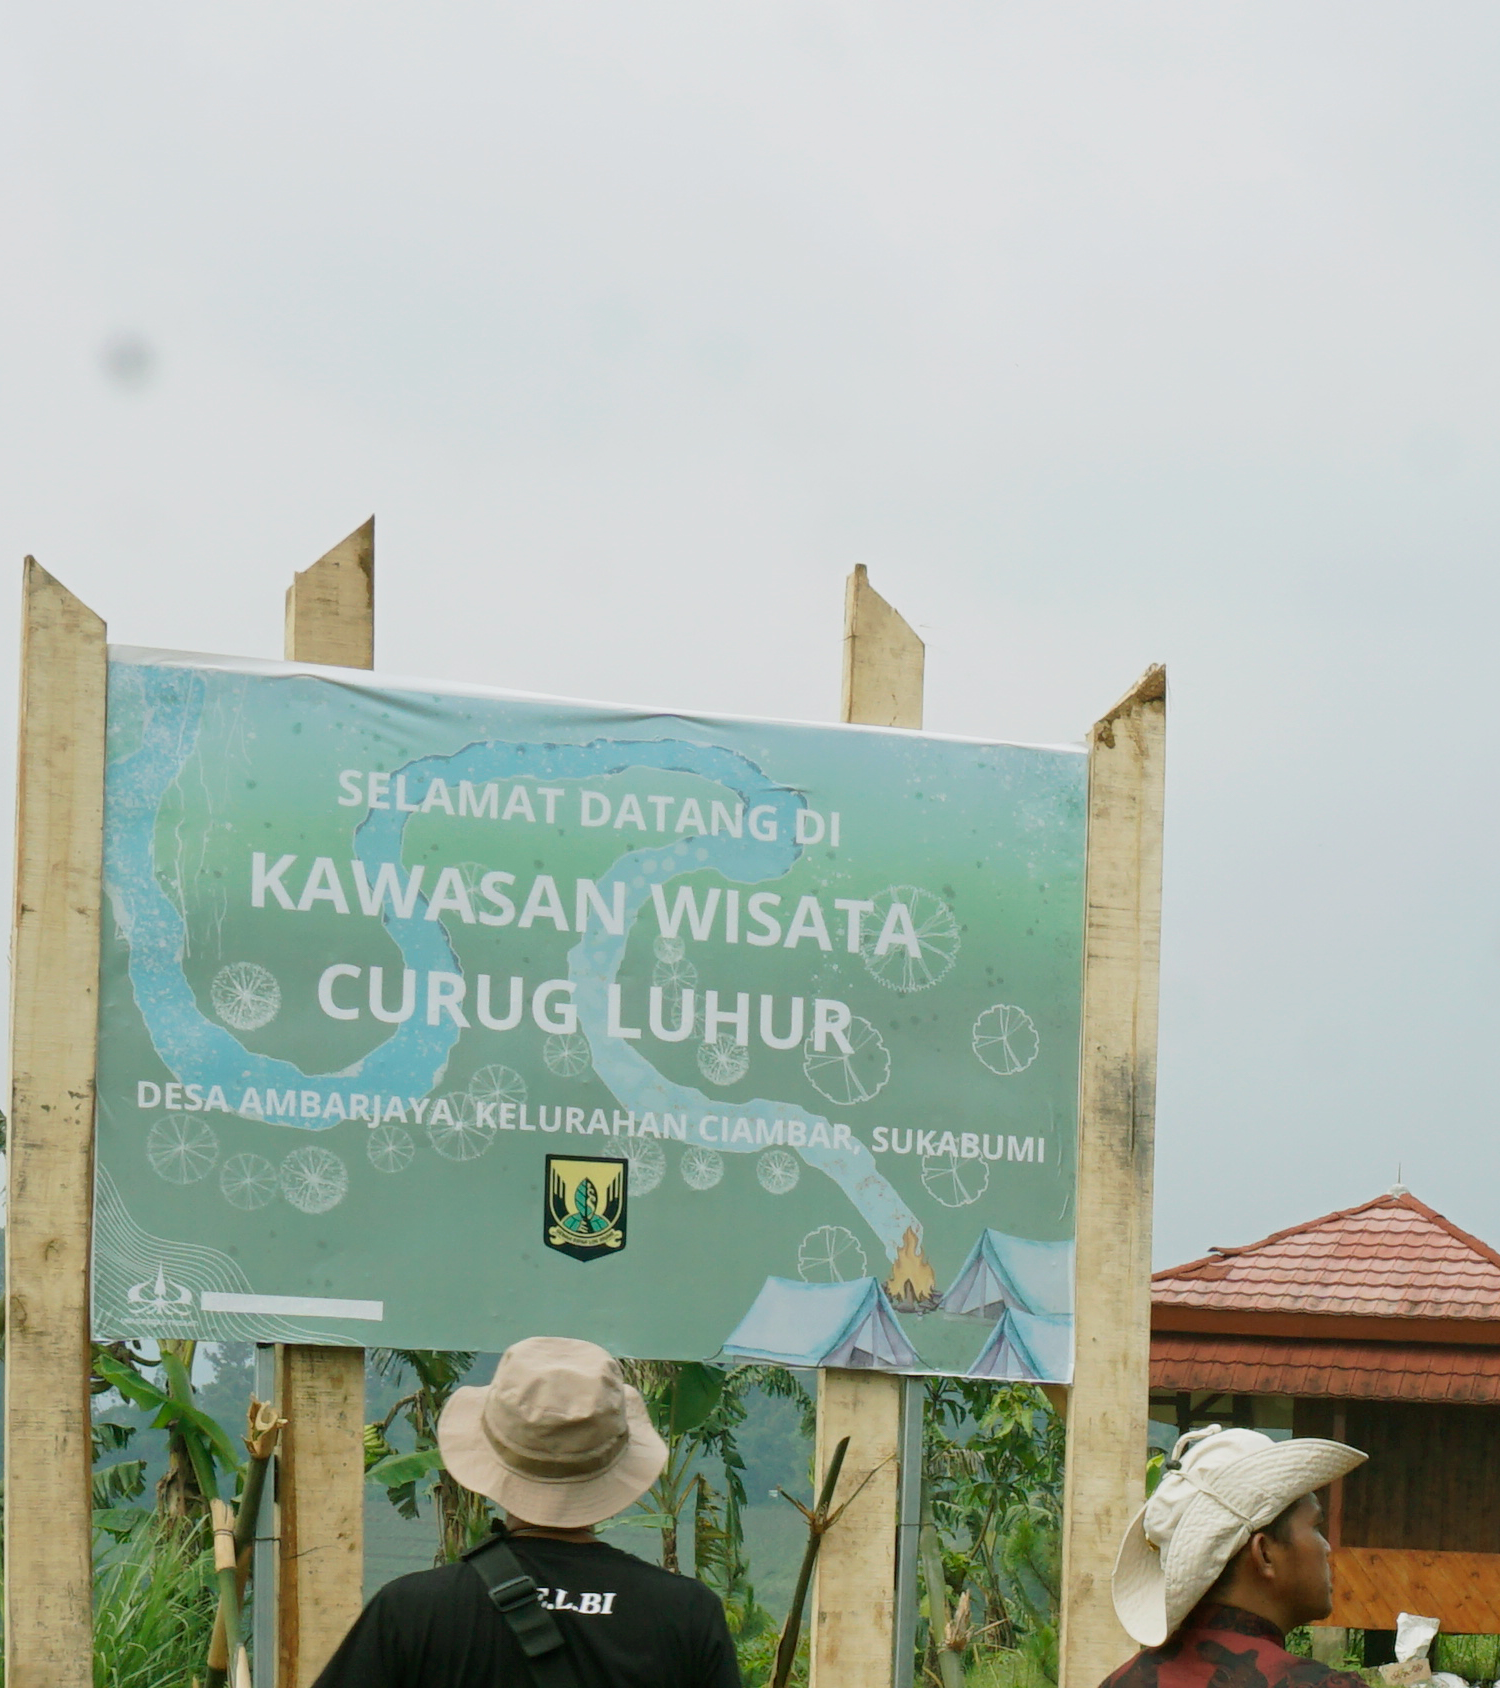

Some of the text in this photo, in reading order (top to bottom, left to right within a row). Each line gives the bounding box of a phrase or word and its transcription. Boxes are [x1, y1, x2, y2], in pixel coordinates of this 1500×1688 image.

[337, 769, 840, 847] SELAMAT DATANG DI
[250, 851, 923, 959] KAWASAN WISATA
[317, 963, 855, 1054] CURUG LUHUR
[136, 1080, 1046, 1164] DESA AMBARJAYA, KELURAHAN CIAMBAR, SUKABUMI
